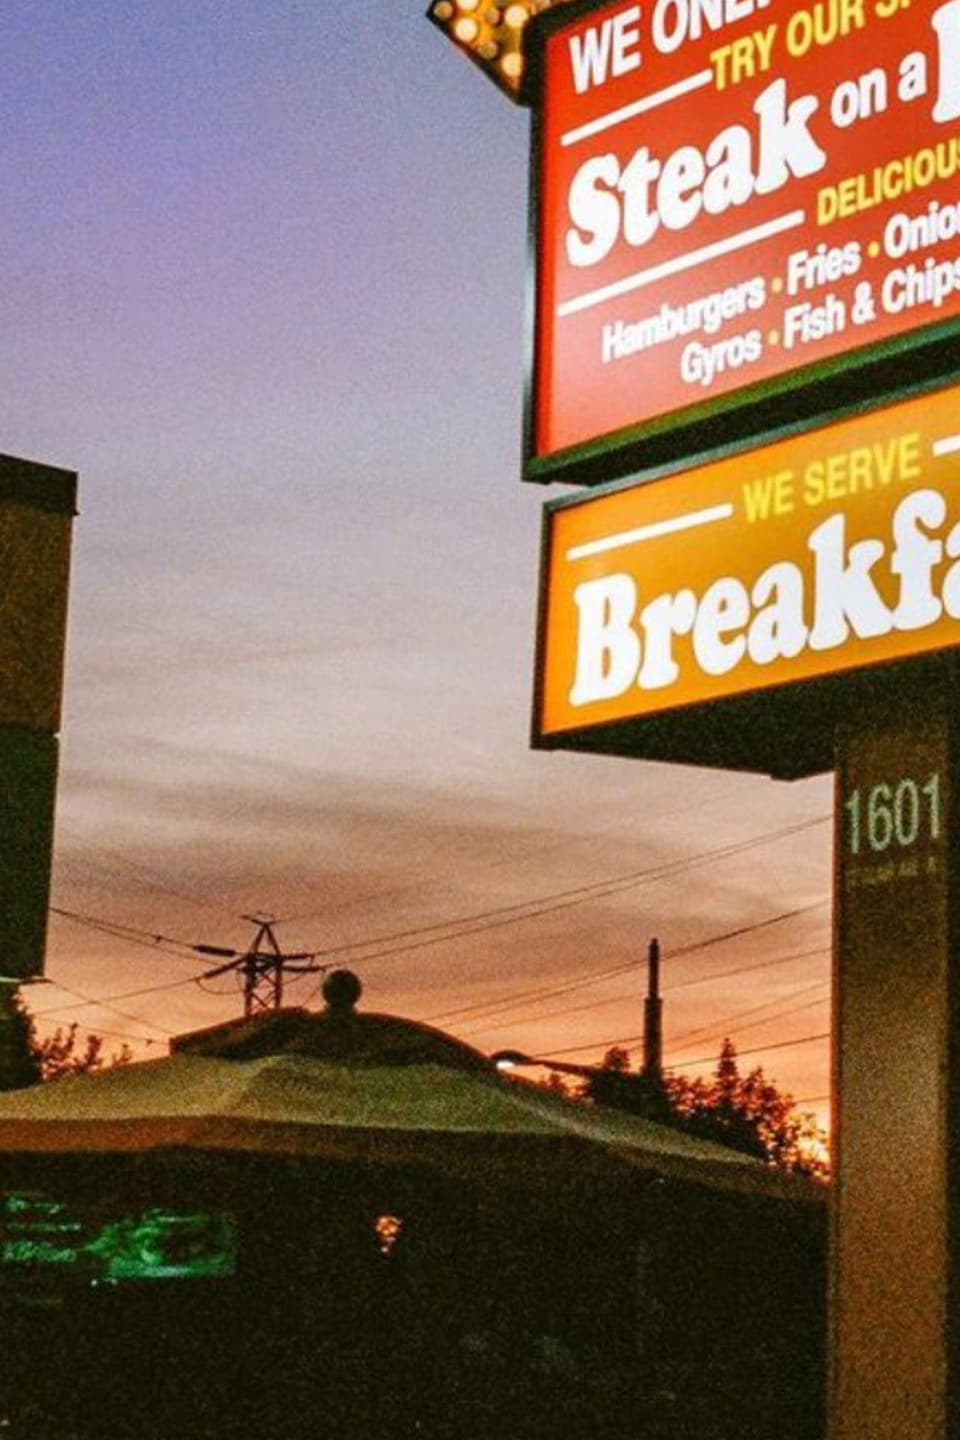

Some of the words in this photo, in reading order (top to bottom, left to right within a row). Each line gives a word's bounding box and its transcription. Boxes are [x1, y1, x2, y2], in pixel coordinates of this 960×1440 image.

[569, 6, 641, 94] WE
[710, 24, 777, 91] TRY
[565, 77, 827, 267] Steak
[830, 67, 888, 128] on
[897, 51, 928, 102] a
[601, 276, 766, 364] Hamburgers
[786, 241, 862, 296] Fries
[679, 327, 763, 386] Gyros
[783, 293, 847, 349] Fish
[851, 280, 876, 325] &
[741, 468, 795, 523] WE
[803, 433, 922, 507] SERVE
[844, 772, 941, 855] 1601
